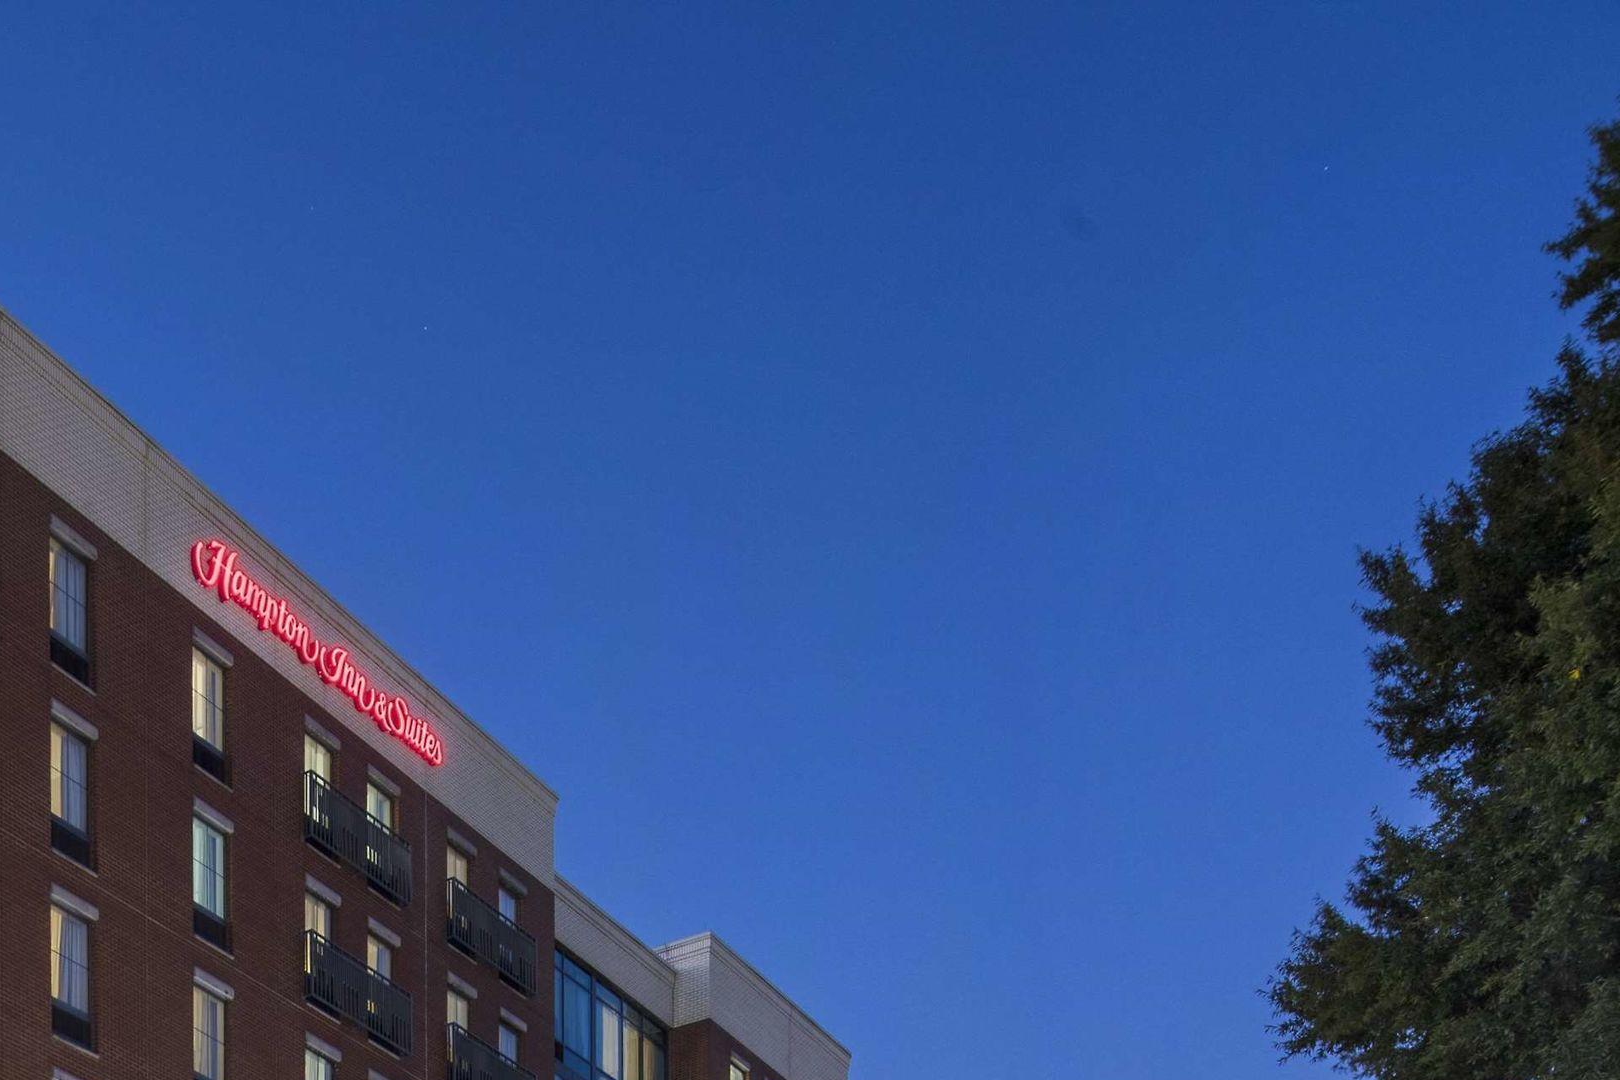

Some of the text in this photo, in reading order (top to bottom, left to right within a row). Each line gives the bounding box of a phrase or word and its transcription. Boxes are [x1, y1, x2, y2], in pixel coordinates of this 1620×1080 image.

[190, 539, 444, 767] Hampton Inn & Suites
